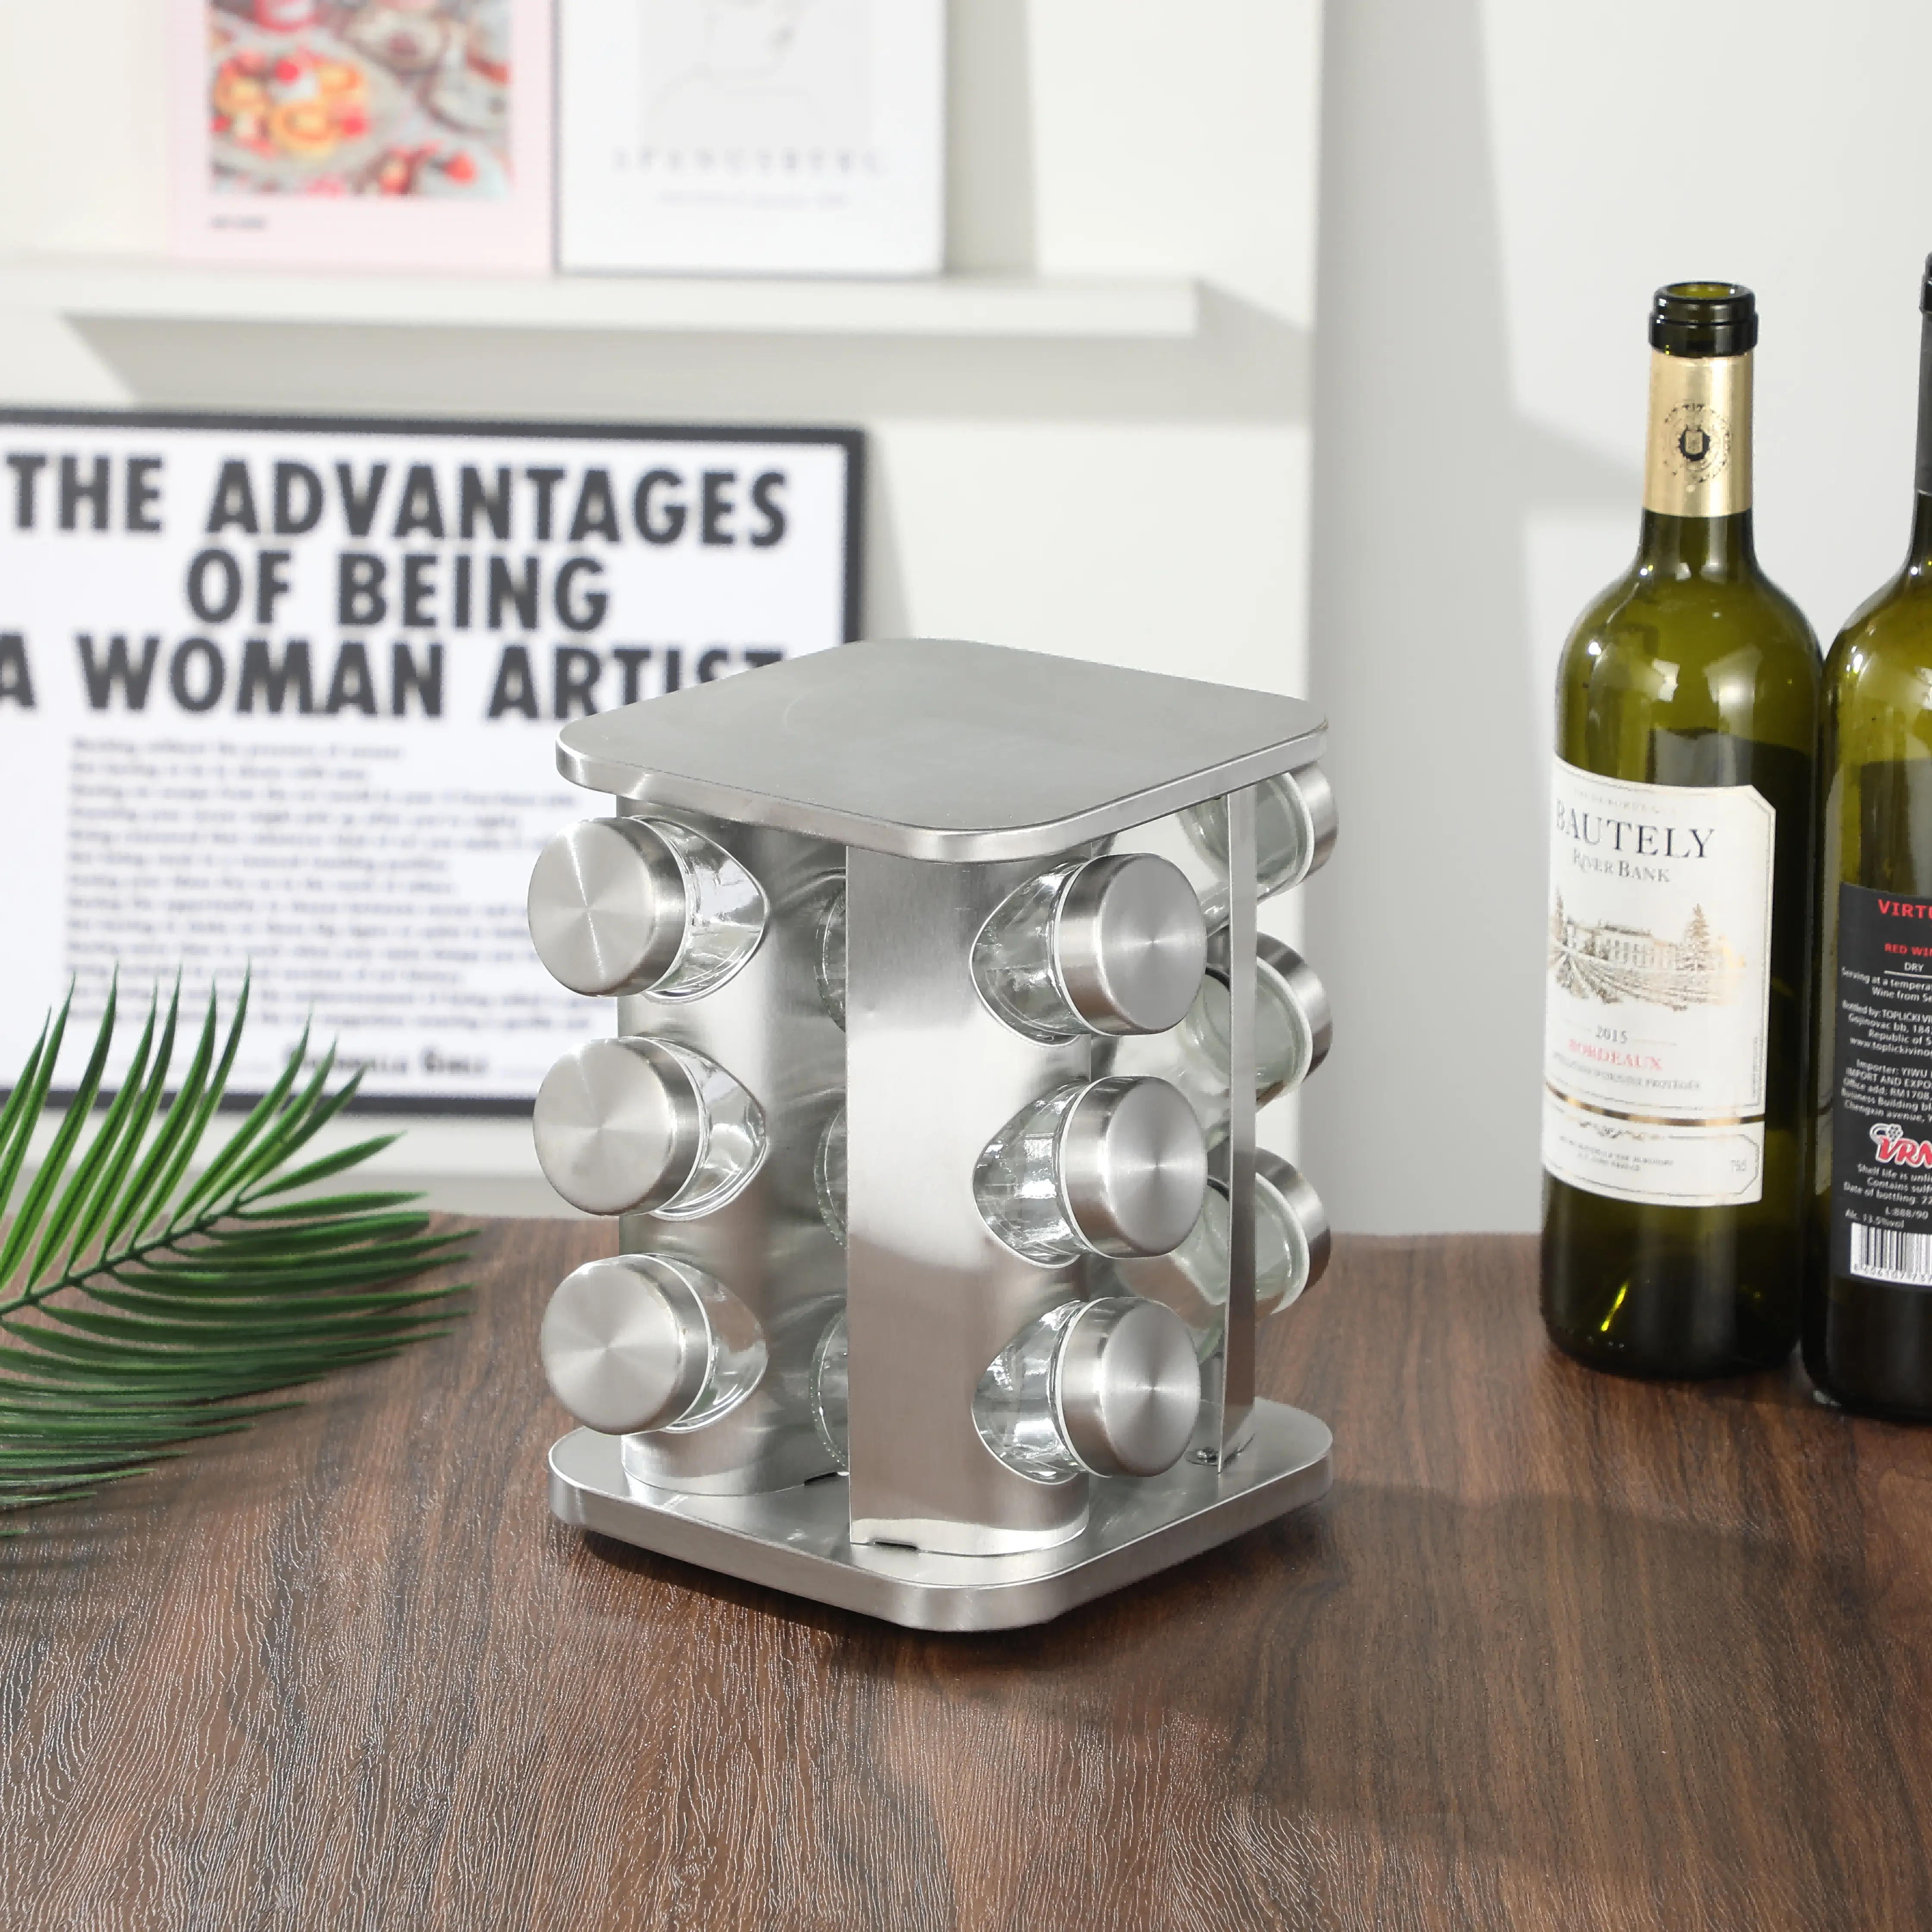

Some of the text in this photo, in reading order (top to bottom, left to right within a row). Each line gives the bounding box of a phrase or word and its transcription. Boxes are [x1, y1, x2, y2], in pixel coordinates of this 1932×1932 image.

[6, 453, 787, 546] THE ADVANTAGES
[186, 548, 608, 633] OF BEING
[0, 633, 784, 719] A WOMAN ARTI
[1556, 798, 1715, 859] BAUTELY
[1884, 942, 1932, 957] RED WI
[1904, 962, 1924, 972] DRY
[1872, 976, 1881, 985] at
[1891, 979, 1932, 991] tempera
[1872, 986, 1895, 999] Wine
[1897, 990, 1919, 1001] from
[1595, 1024, 1629, 1044] 2015
[1868, 1029, 1909, 1044] Republic
[1912, 1035, 1923, 1045] of
[1913, 1024, 1932, 1035] 184
[1901, 1067, 1928, 1079] YIWU
[1880, 1075, 1902, 1087] AND
[1878, 1095, 1919, 1113] Building
[1843, 1181, 1863, 1195] Date
[1867, 1177, 1909, 1192] Contains
